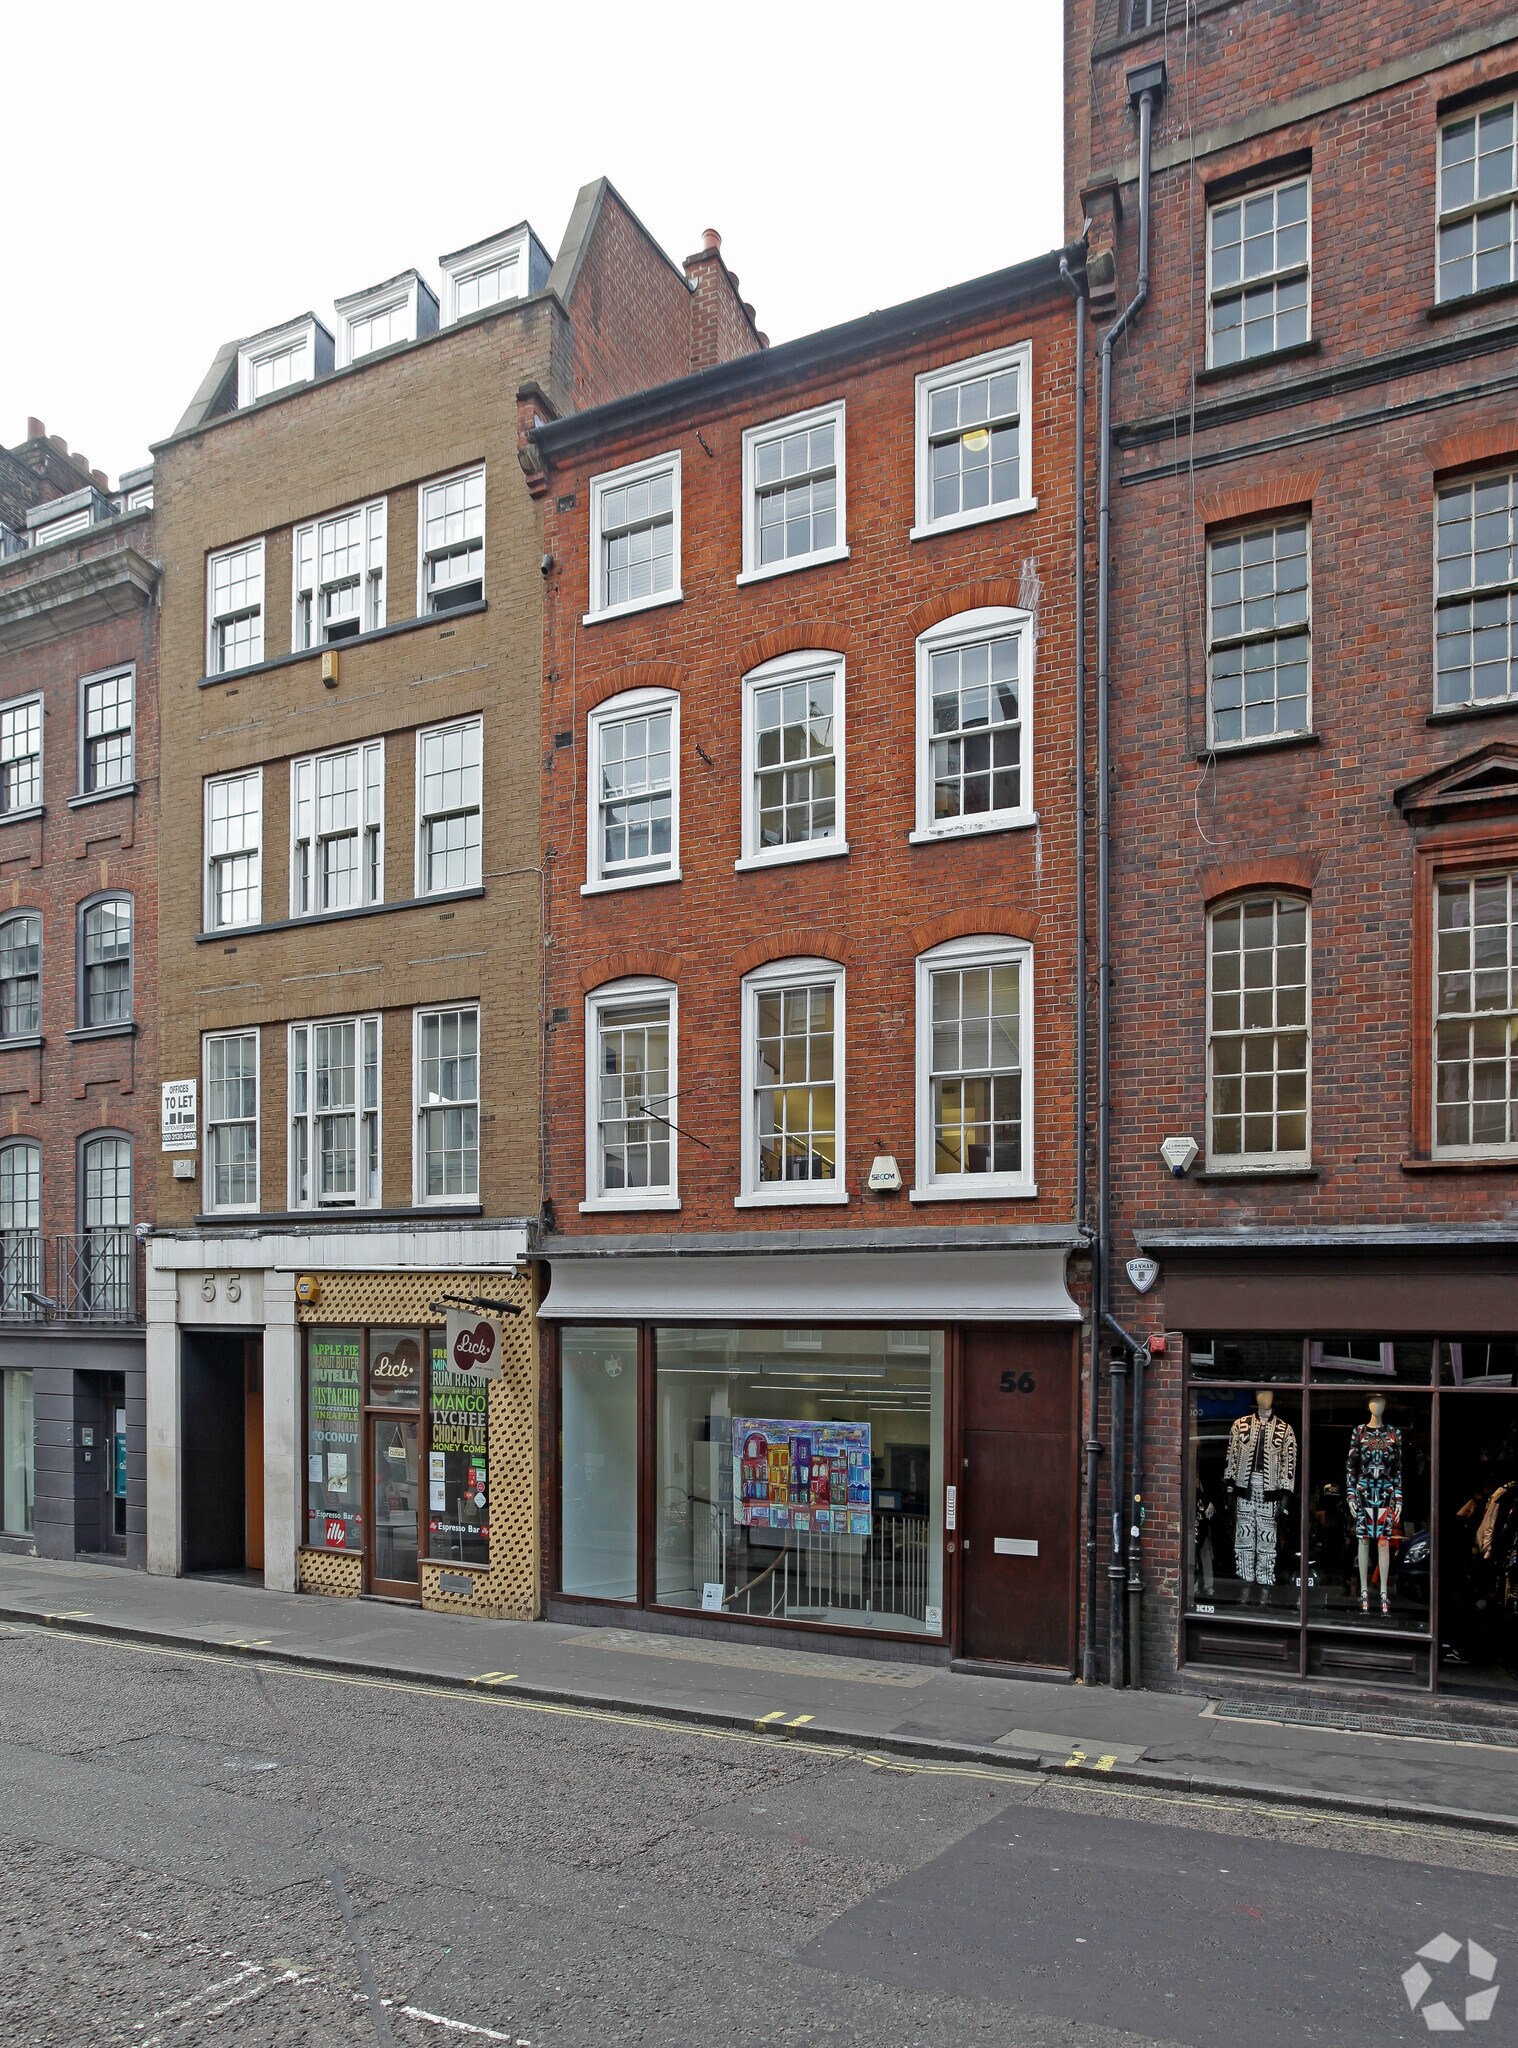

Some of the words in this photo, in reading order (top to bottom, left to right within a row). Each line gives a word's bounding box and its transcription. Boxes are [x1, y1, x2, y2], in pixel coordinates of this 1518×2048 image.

[169, 1084, 189, 1094] OFFICES
[165, 1097, 176, 1109] TO
[178, 1095, 193, 1108] LET
[871, 1173, 895, 1181] SECOM
[312, 1344, 341, 1355] APPLE
[343, 1345, 359, 1356] PIE
[336, 1356, 359, 1370] BUTTER
[312, 1368, 359, 1383] NUTELLA
[433, 1371, 452, 1387] RUM
[455, 1373, 486, 1388] RAISIN
[1000, 1371, 1036, 1394] 56
[312, 1386, 359, 1407] PISTACHIO
[432, 1393, 487, 1412] MANGO
[312, 1410, 359, 1421] PINEAPPLE
[433, 1410, 486, 1426] LYCHEE
[331, 1420, 359, 1433] CHERRY
[311, 1431, 359, 1443] COCONUT
[433, 1424, 486, 1446] CHOCOLATE
[432, 1443, 460, 1452] HONEY
[462, 1445, 487, 1453] COMB
[316, 1510, 341, 1519] Espresso
[327, 1522, 345, 1544] illy
[438, 1522, 465, 1532] Espresso
